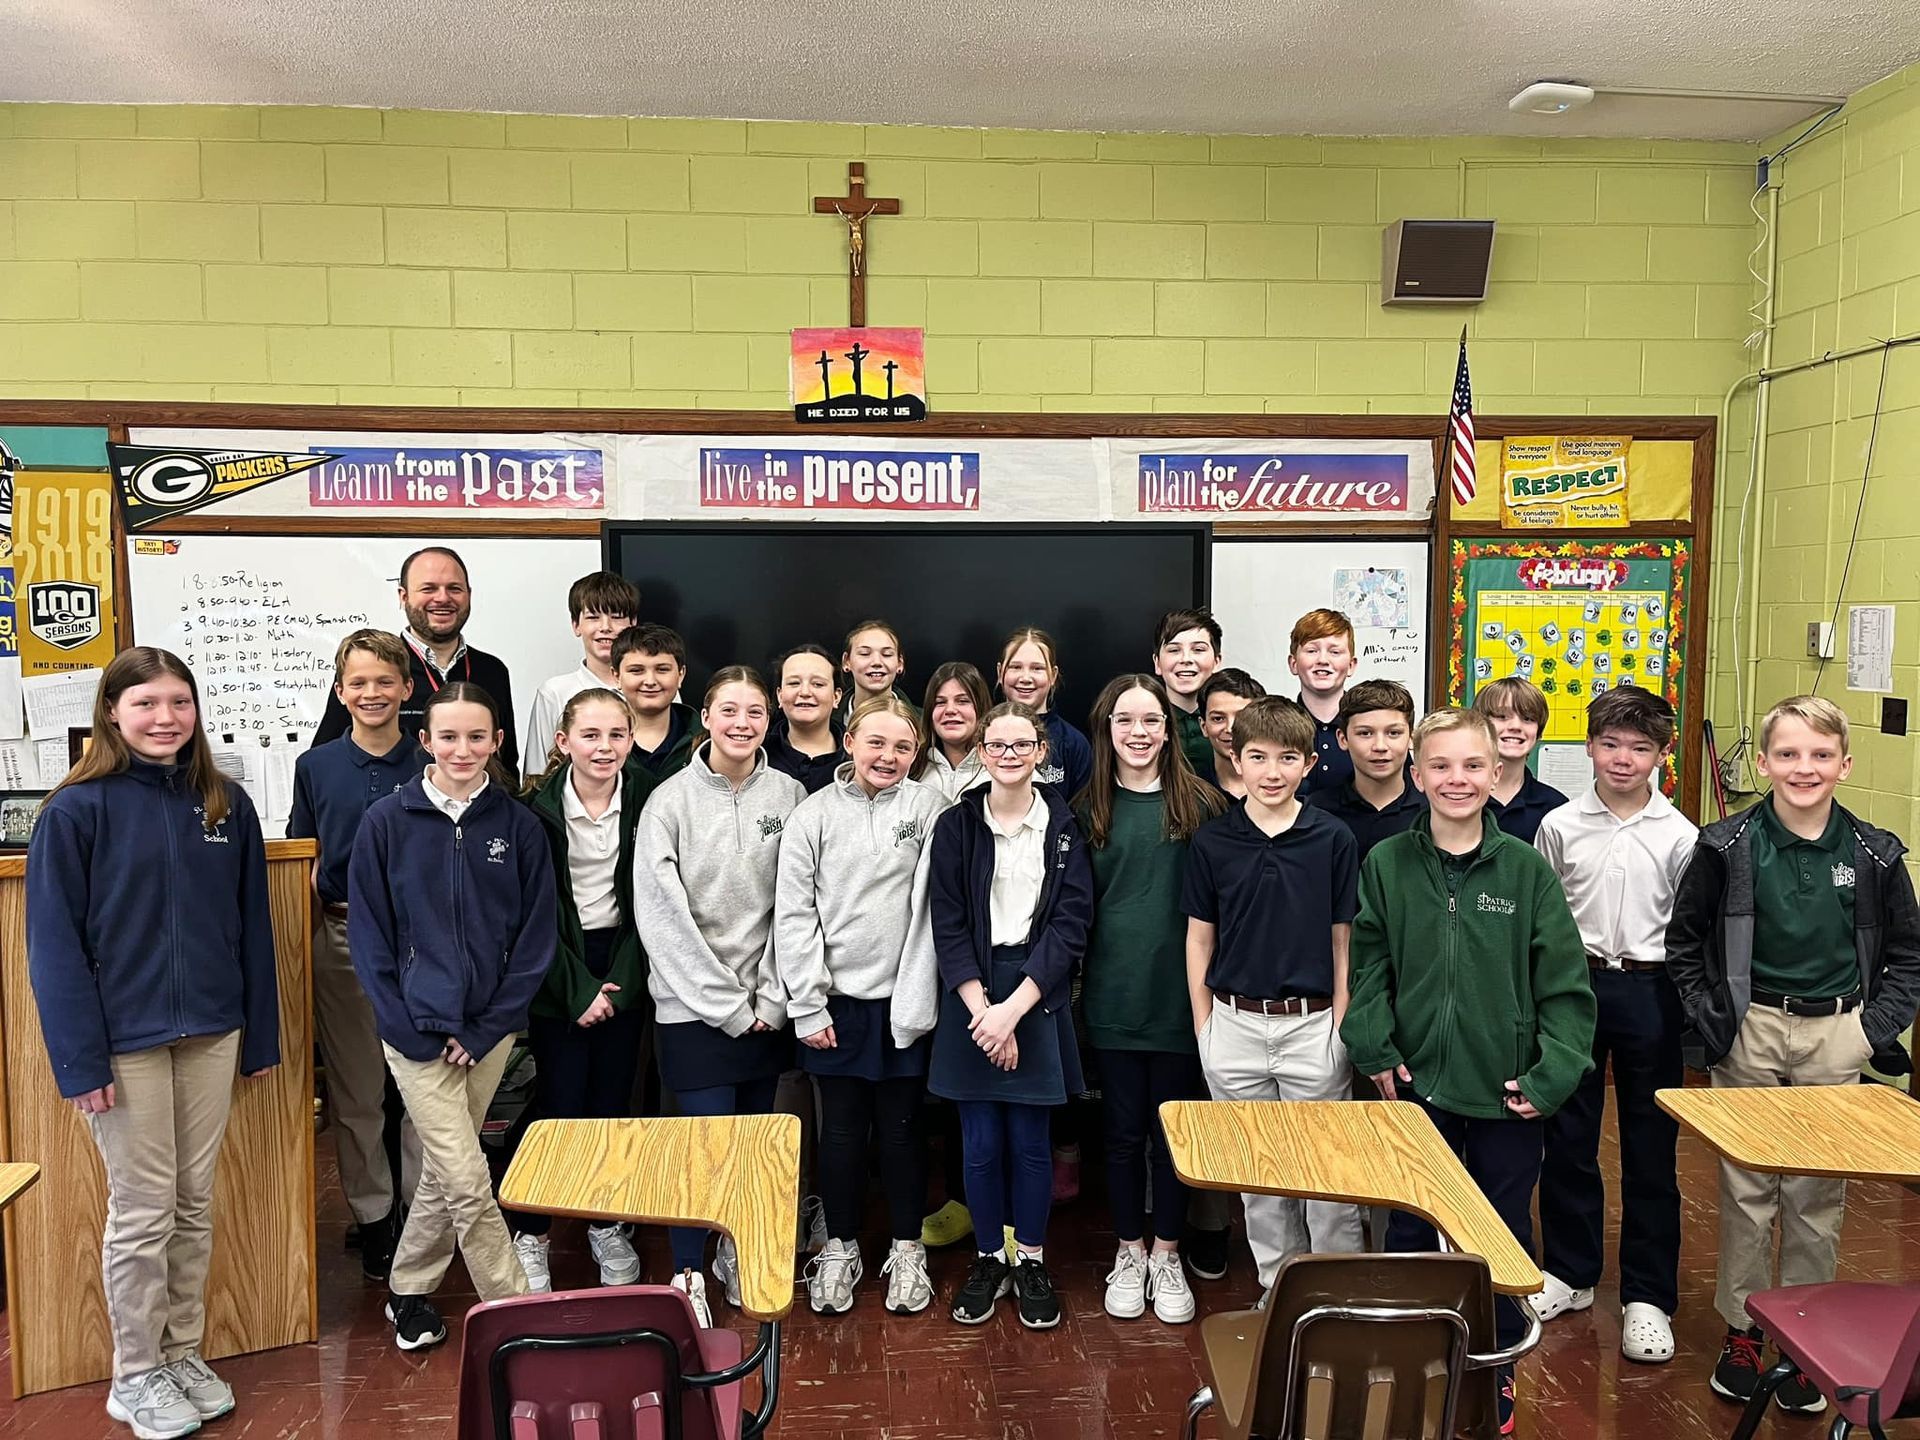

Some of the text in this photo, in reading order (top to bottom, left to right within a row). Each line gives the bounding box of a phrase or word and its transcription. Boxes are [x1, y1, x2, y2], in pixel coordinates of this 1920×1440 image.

[807, 407, 910, 418] HE DIED FOR US
[1574, 441, 1592, 449] good
[1582, 449, 1612, 457] language
[215, 455, 286, 482] PACKERS
[317, 450, 456, 501] Learn from
[705, 451, 788, 501] live in
[406, 477, 448, 501] the
[756, 455, 977, 508] the present,
[1144, 458, 1238, 512] plan for
[1201, 459, 1401, 511] the future.
[1512, 466, 1618, 497] RESPECT
[15, 487, 112, 545] 1919
[1523, 510, 1559, 518] considerate
[1529, 517, 1554, 526] feelings
[37, 590, 92, 617] 100
[180, 602, 188, 611] 2
[262, 595, 291, 608] ELA
[45, 621, 92, 639] SEASONS
[184, 621, 192, 632] 3
[267, 615, 280, 625] PE
[185, 637, 192, 648] 4
[268, 628, 294, 641] Math
[1656, 634, 1663, 643] 10
[187, 654, 194, 666] 5
[271, 647, 312, 660] History
[1373, 656, 1406, 664] artwork
[1523, 659, 1531, 668] 12
[1601, 658, 1607, 667] 15
[1653, 660, 1660, 669] 17
[276, 697, 296, 709] Lit
[279, 715, 318, 729] Science
[204, 834, 229, 843] School
